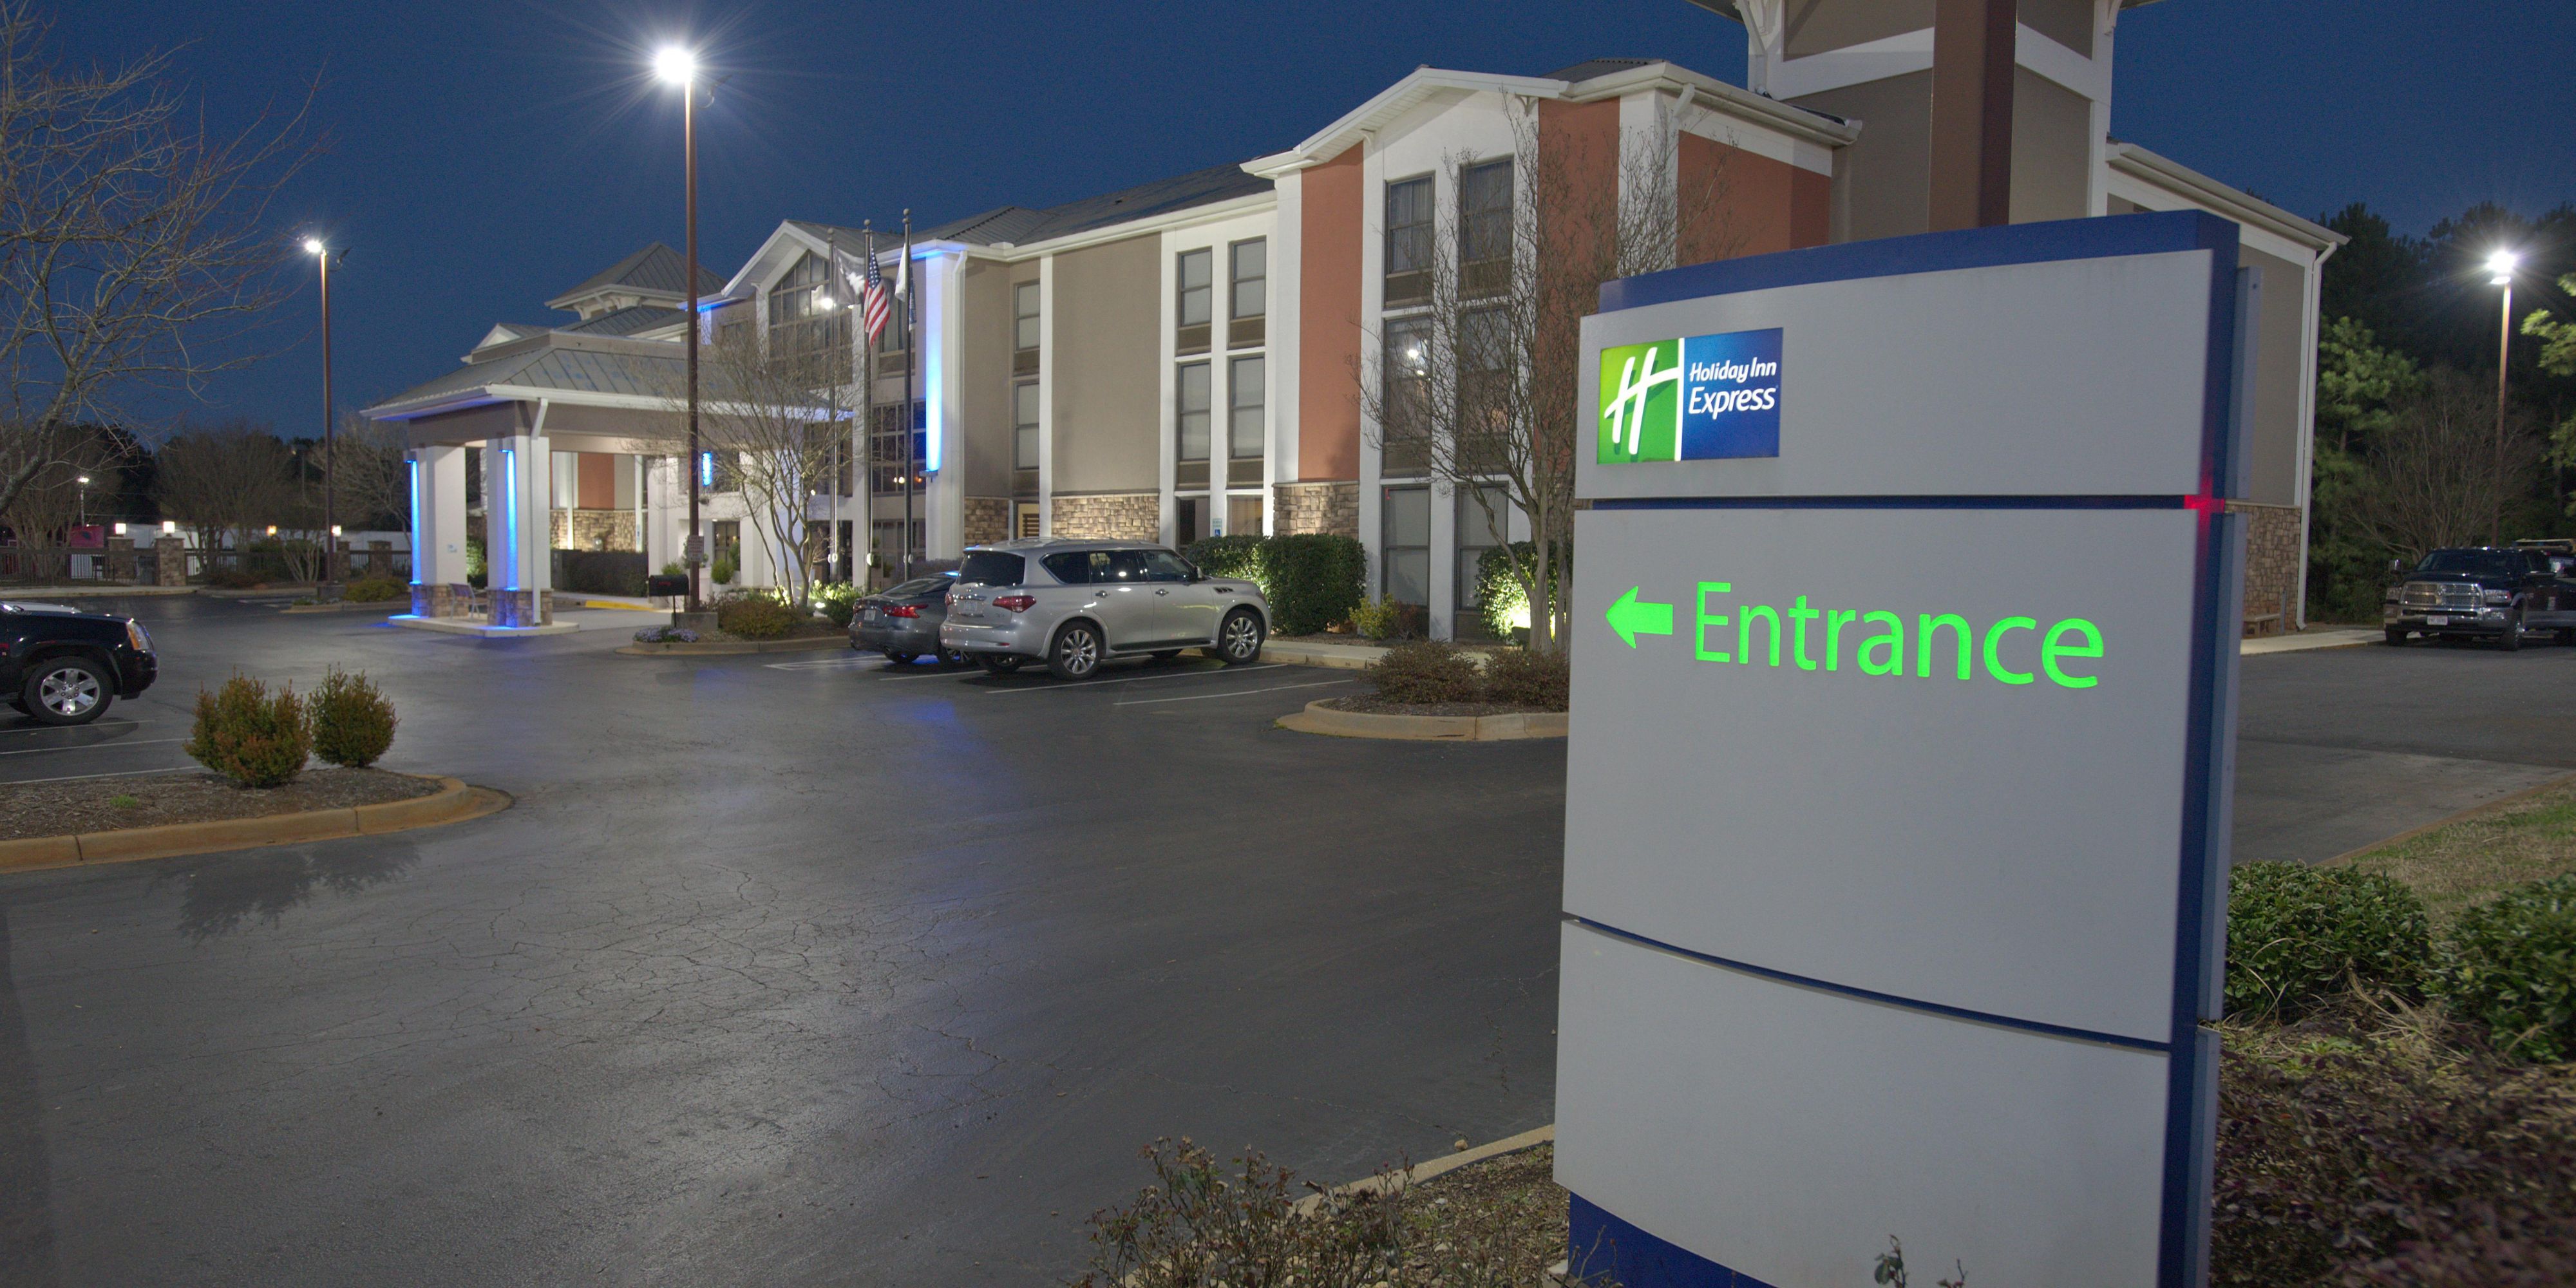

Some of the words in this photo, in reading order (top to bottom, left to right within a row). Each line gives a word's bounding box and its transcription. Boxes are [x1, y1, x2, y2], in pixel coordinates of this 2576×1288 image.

[1689, 359, 1748, 383] Holiday
[1750, 356, 1777, 377] Inn
[1688, 386, 1776, 420] Express
[1694, 580, 2104, 688] Entrance
